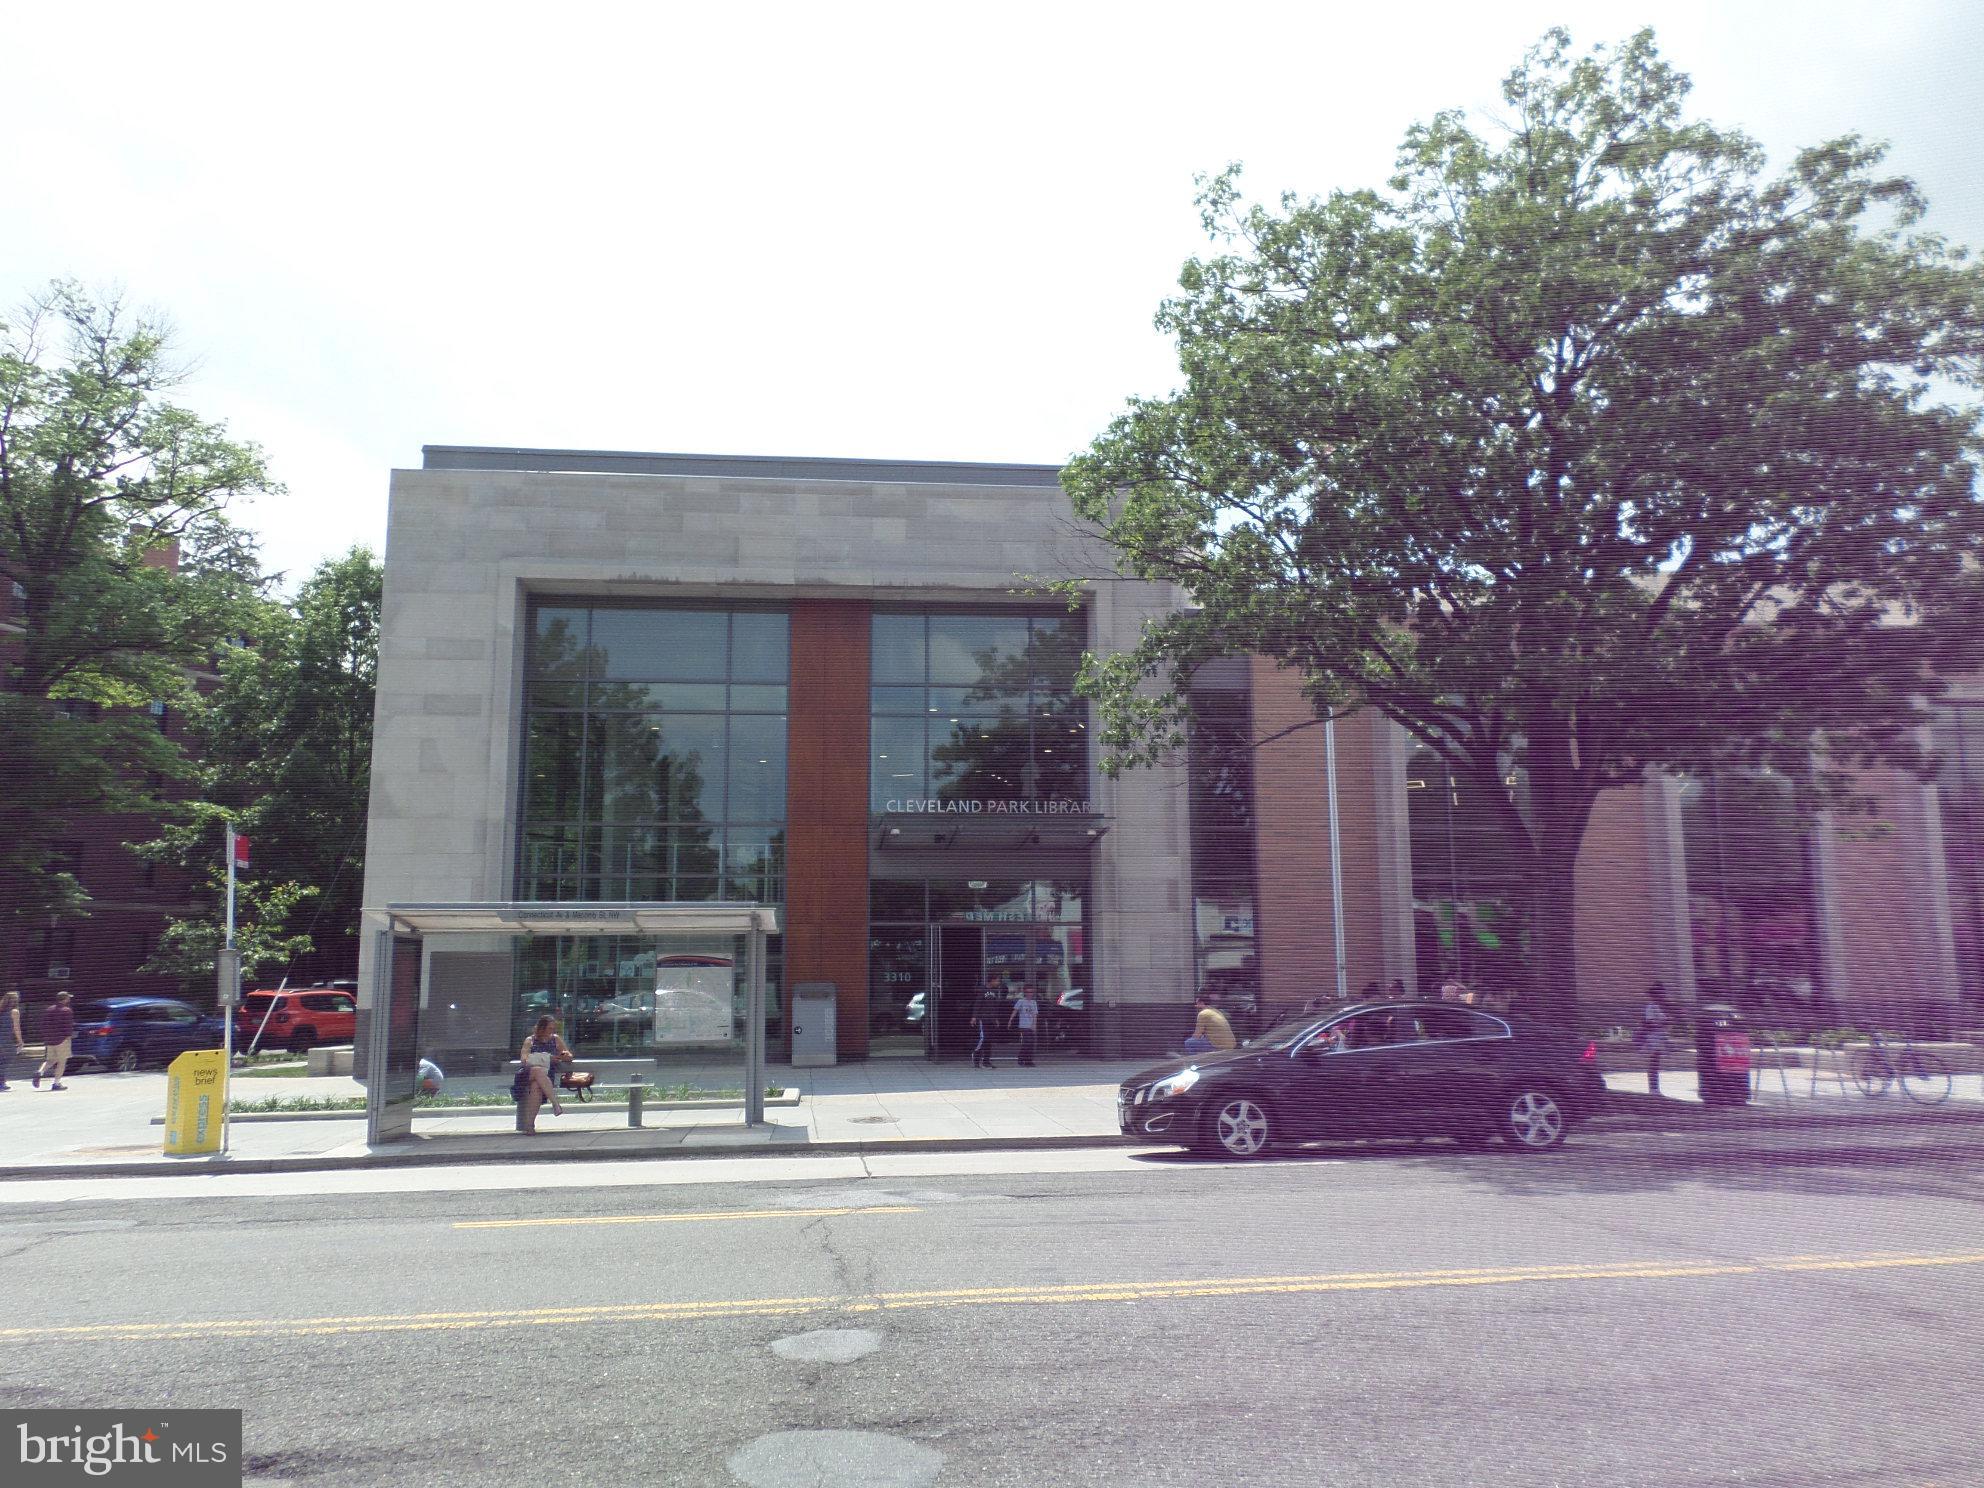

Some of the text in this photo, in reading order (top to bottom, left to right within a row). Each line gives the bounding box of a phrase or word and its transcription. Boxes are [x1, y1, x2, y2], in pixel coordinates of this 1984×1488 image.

[886, 799, 1093, 814] CLEVELAND PARK LIBRAR
[883, 971, 911, 982] 3310
[193, 1069, 218, 1077] news
[195, 1076, 216, 1085] brief
